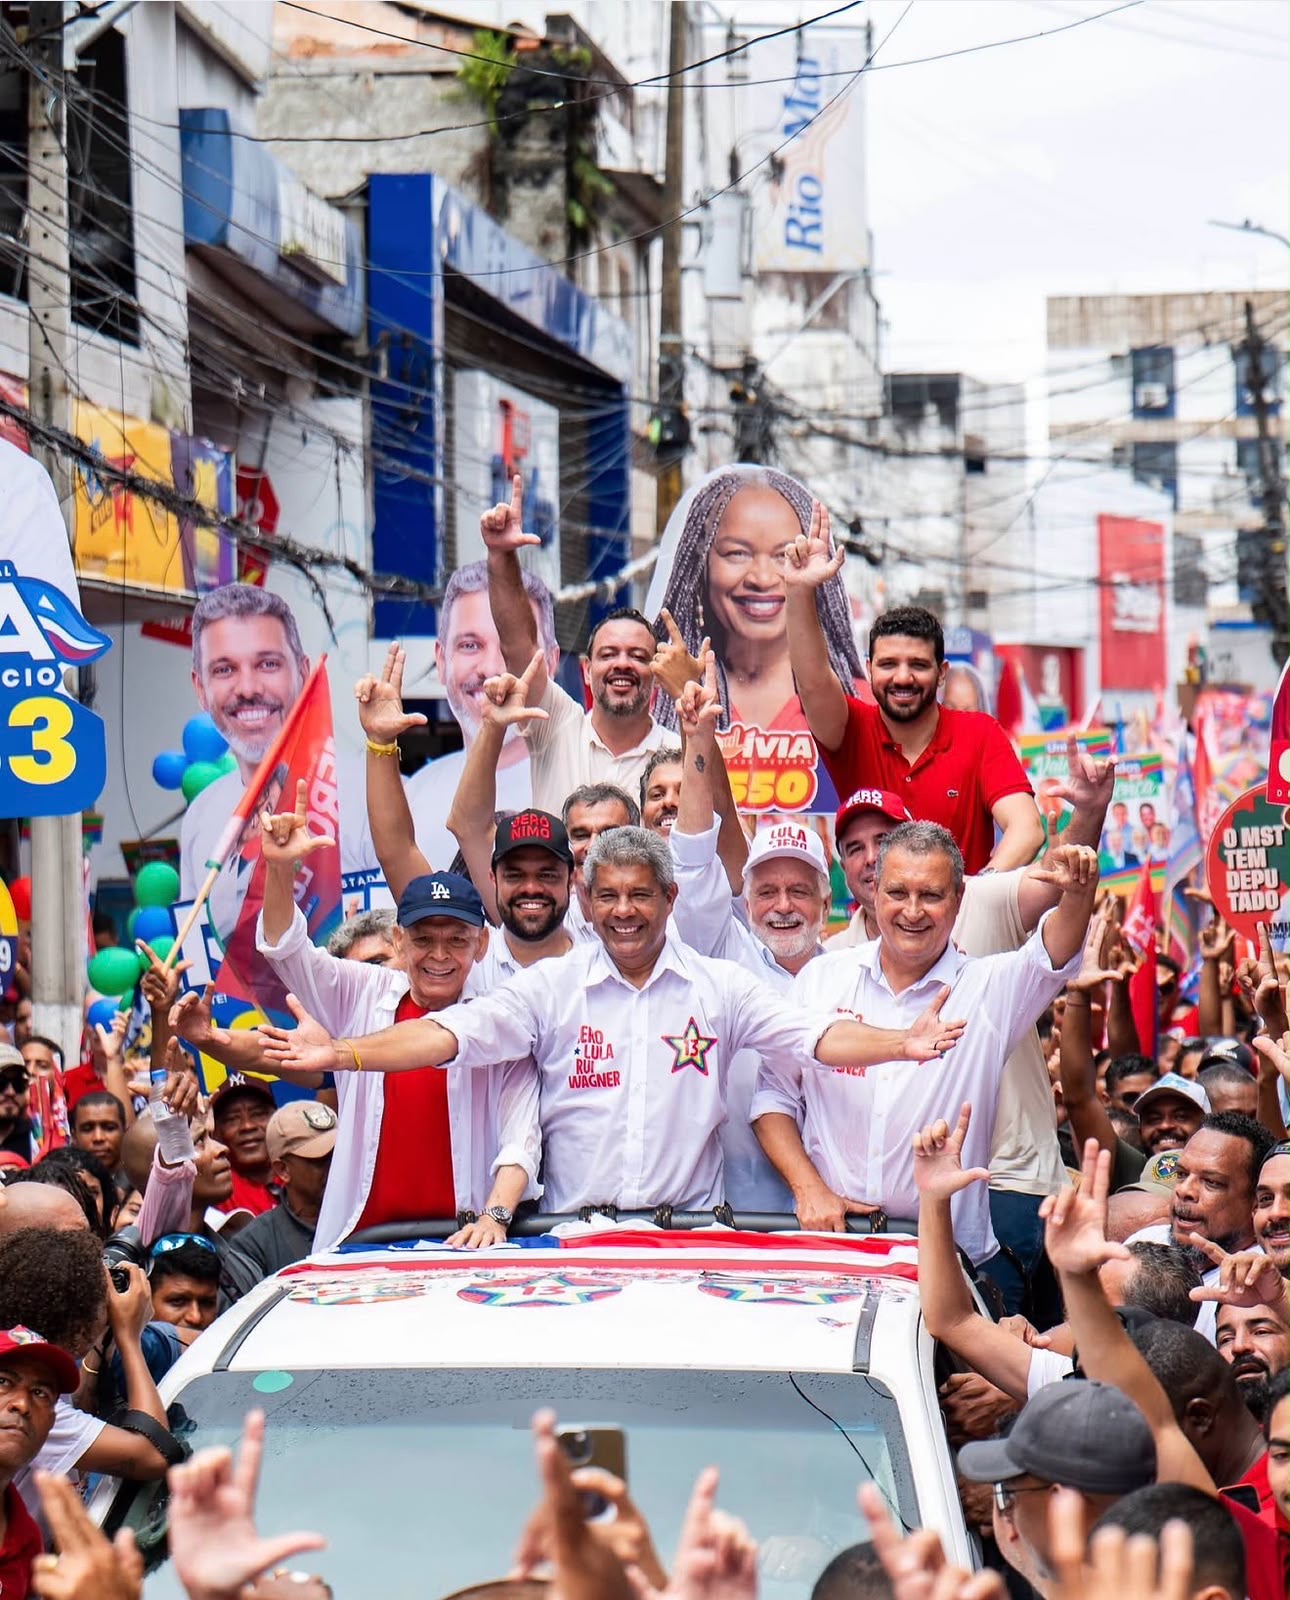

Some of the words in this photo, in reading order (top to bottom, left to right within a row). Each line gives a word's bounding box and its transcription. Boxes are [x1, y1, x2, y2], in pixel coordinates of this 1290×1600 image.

[784, 174, 823, 254] Rio
[770, 826, 807, 843] LULA
[1223, 828, 1238, 848] O
[1241, 825, 1285, 848] MST
[1224, 849, 1267, 870] TEM
[1226, 868, 1279, 892] DEPU
[431, 881, 451, 900] LA
[1227, 890, 1280, 912] TADO
[579, 1025, 604, 1044] ERO
[584, 1043, 614, 1060] LULA
[683, 1039, 699, 1057] 13
[576, 1059, 594, 1074] RUI
[569, 1070, 621, 1089] WAGNER
[522, 1285, 567, 1296] 13
